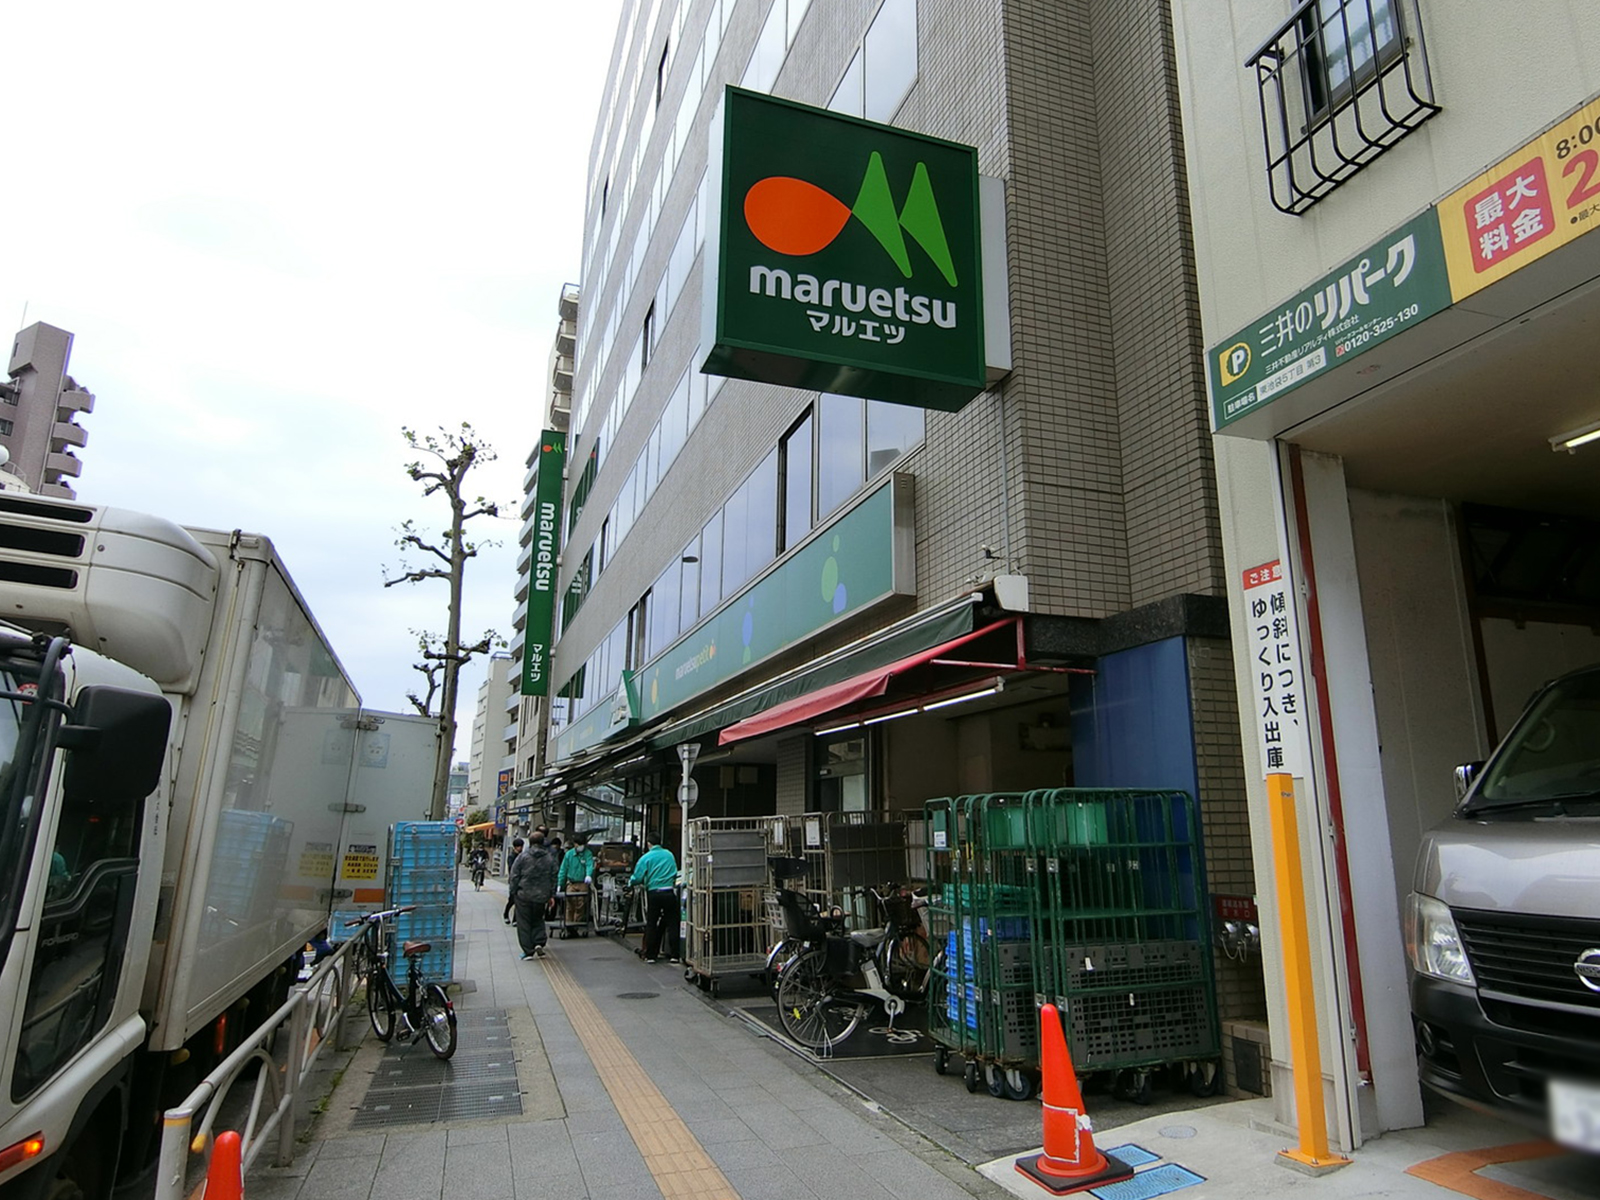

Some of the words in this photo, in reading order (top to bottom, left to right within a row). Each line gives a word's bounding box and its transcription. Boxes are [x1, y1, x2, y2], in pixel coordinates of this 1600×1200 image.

[1475, 174, 1538, 230] 最大
[1479, 207, 1544, 260] 料金
[749, 265, 957, 328] maruetsu
[1259, 233, 1416, 357] 三井のリパーク
[806, 310, 906, 344] マルエツ
[1344, 303, 1418, 352] 0120-325-130
[535, 502, 555, 591] maruetsu
[531, 643, 543, 682] マルエツ
[1252, 598, 1285, 769] ゆっくり入出庫
